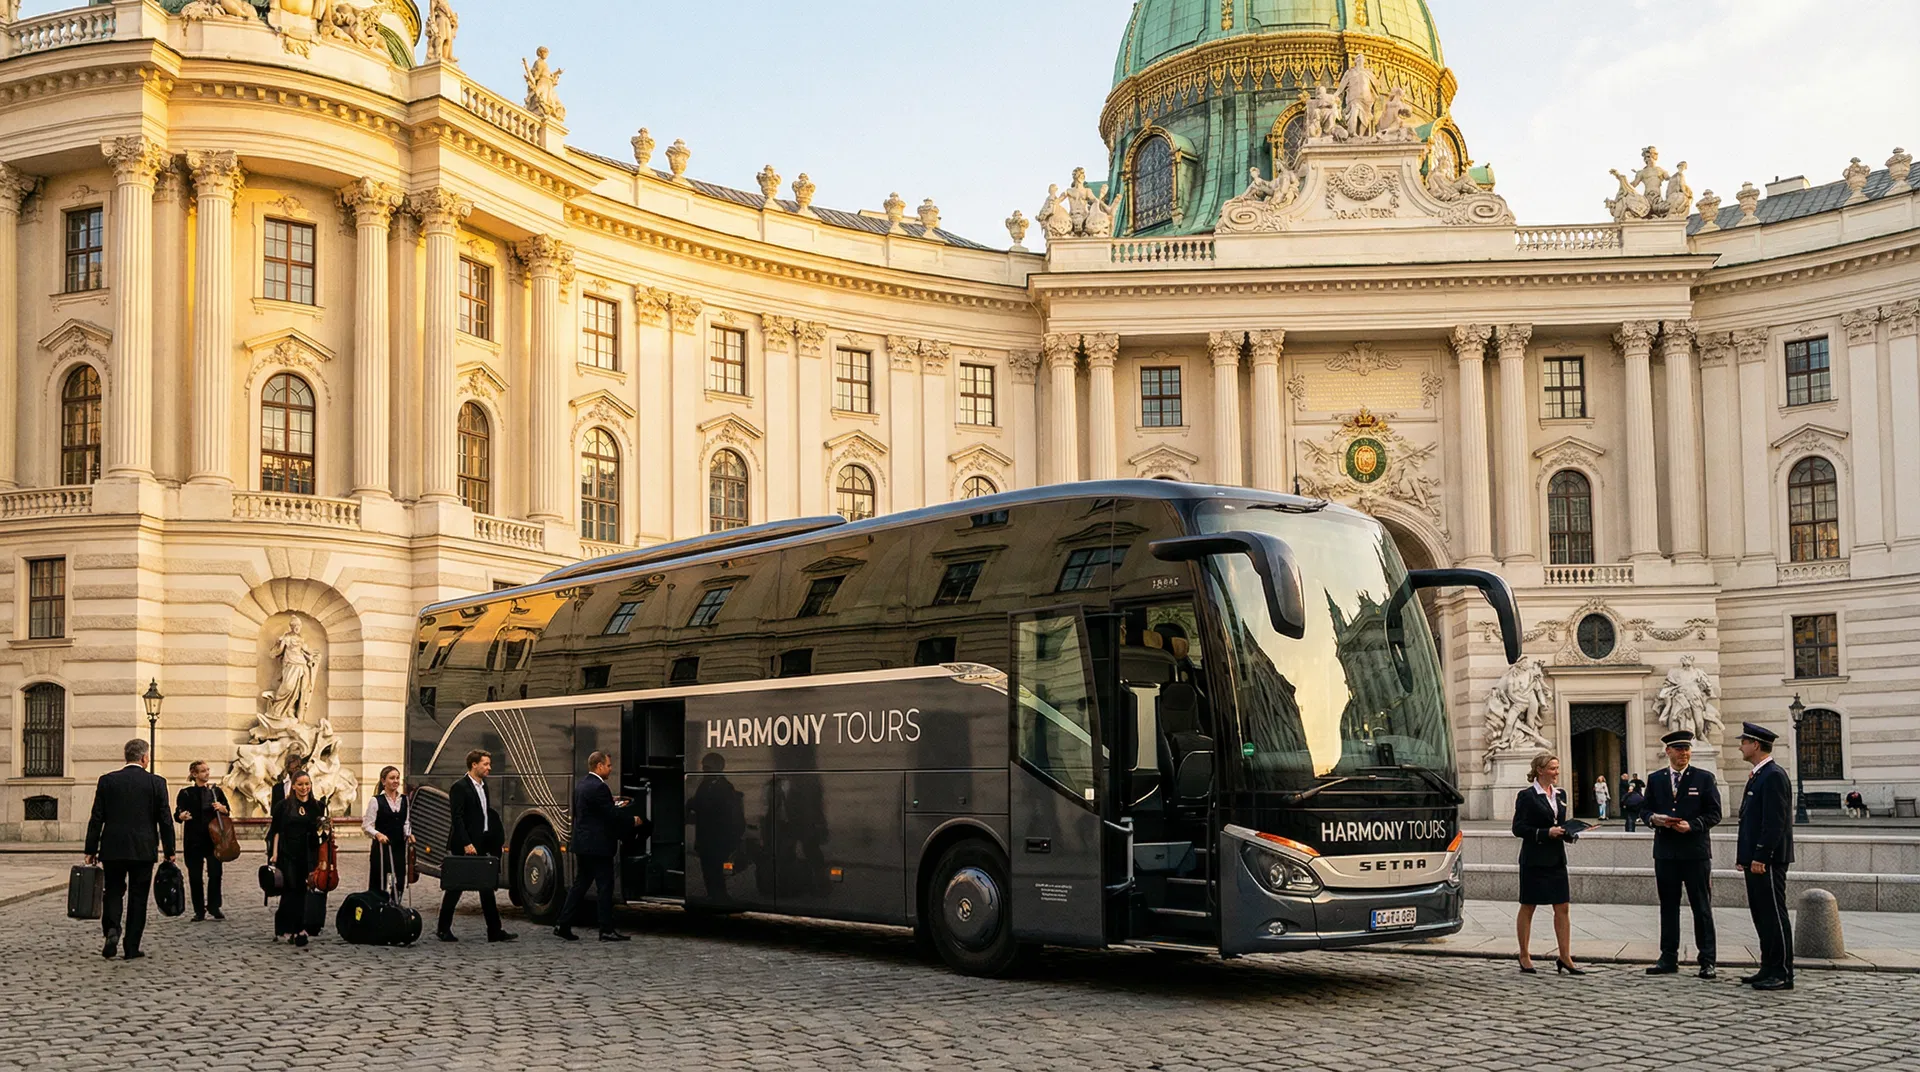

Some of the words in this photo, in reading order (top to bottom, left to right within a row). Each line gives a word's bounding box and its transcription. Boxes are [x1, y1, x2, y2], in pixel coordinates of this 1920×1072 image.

[707, 713, 826, 748] HARMONY
[833, 708, 921, 744] TOURS
[1321, 821, 1404, 842] HARMONY
[1407, 820, 1446, 839] TOURS
[1360, 859, 1426, 871] SETRA
